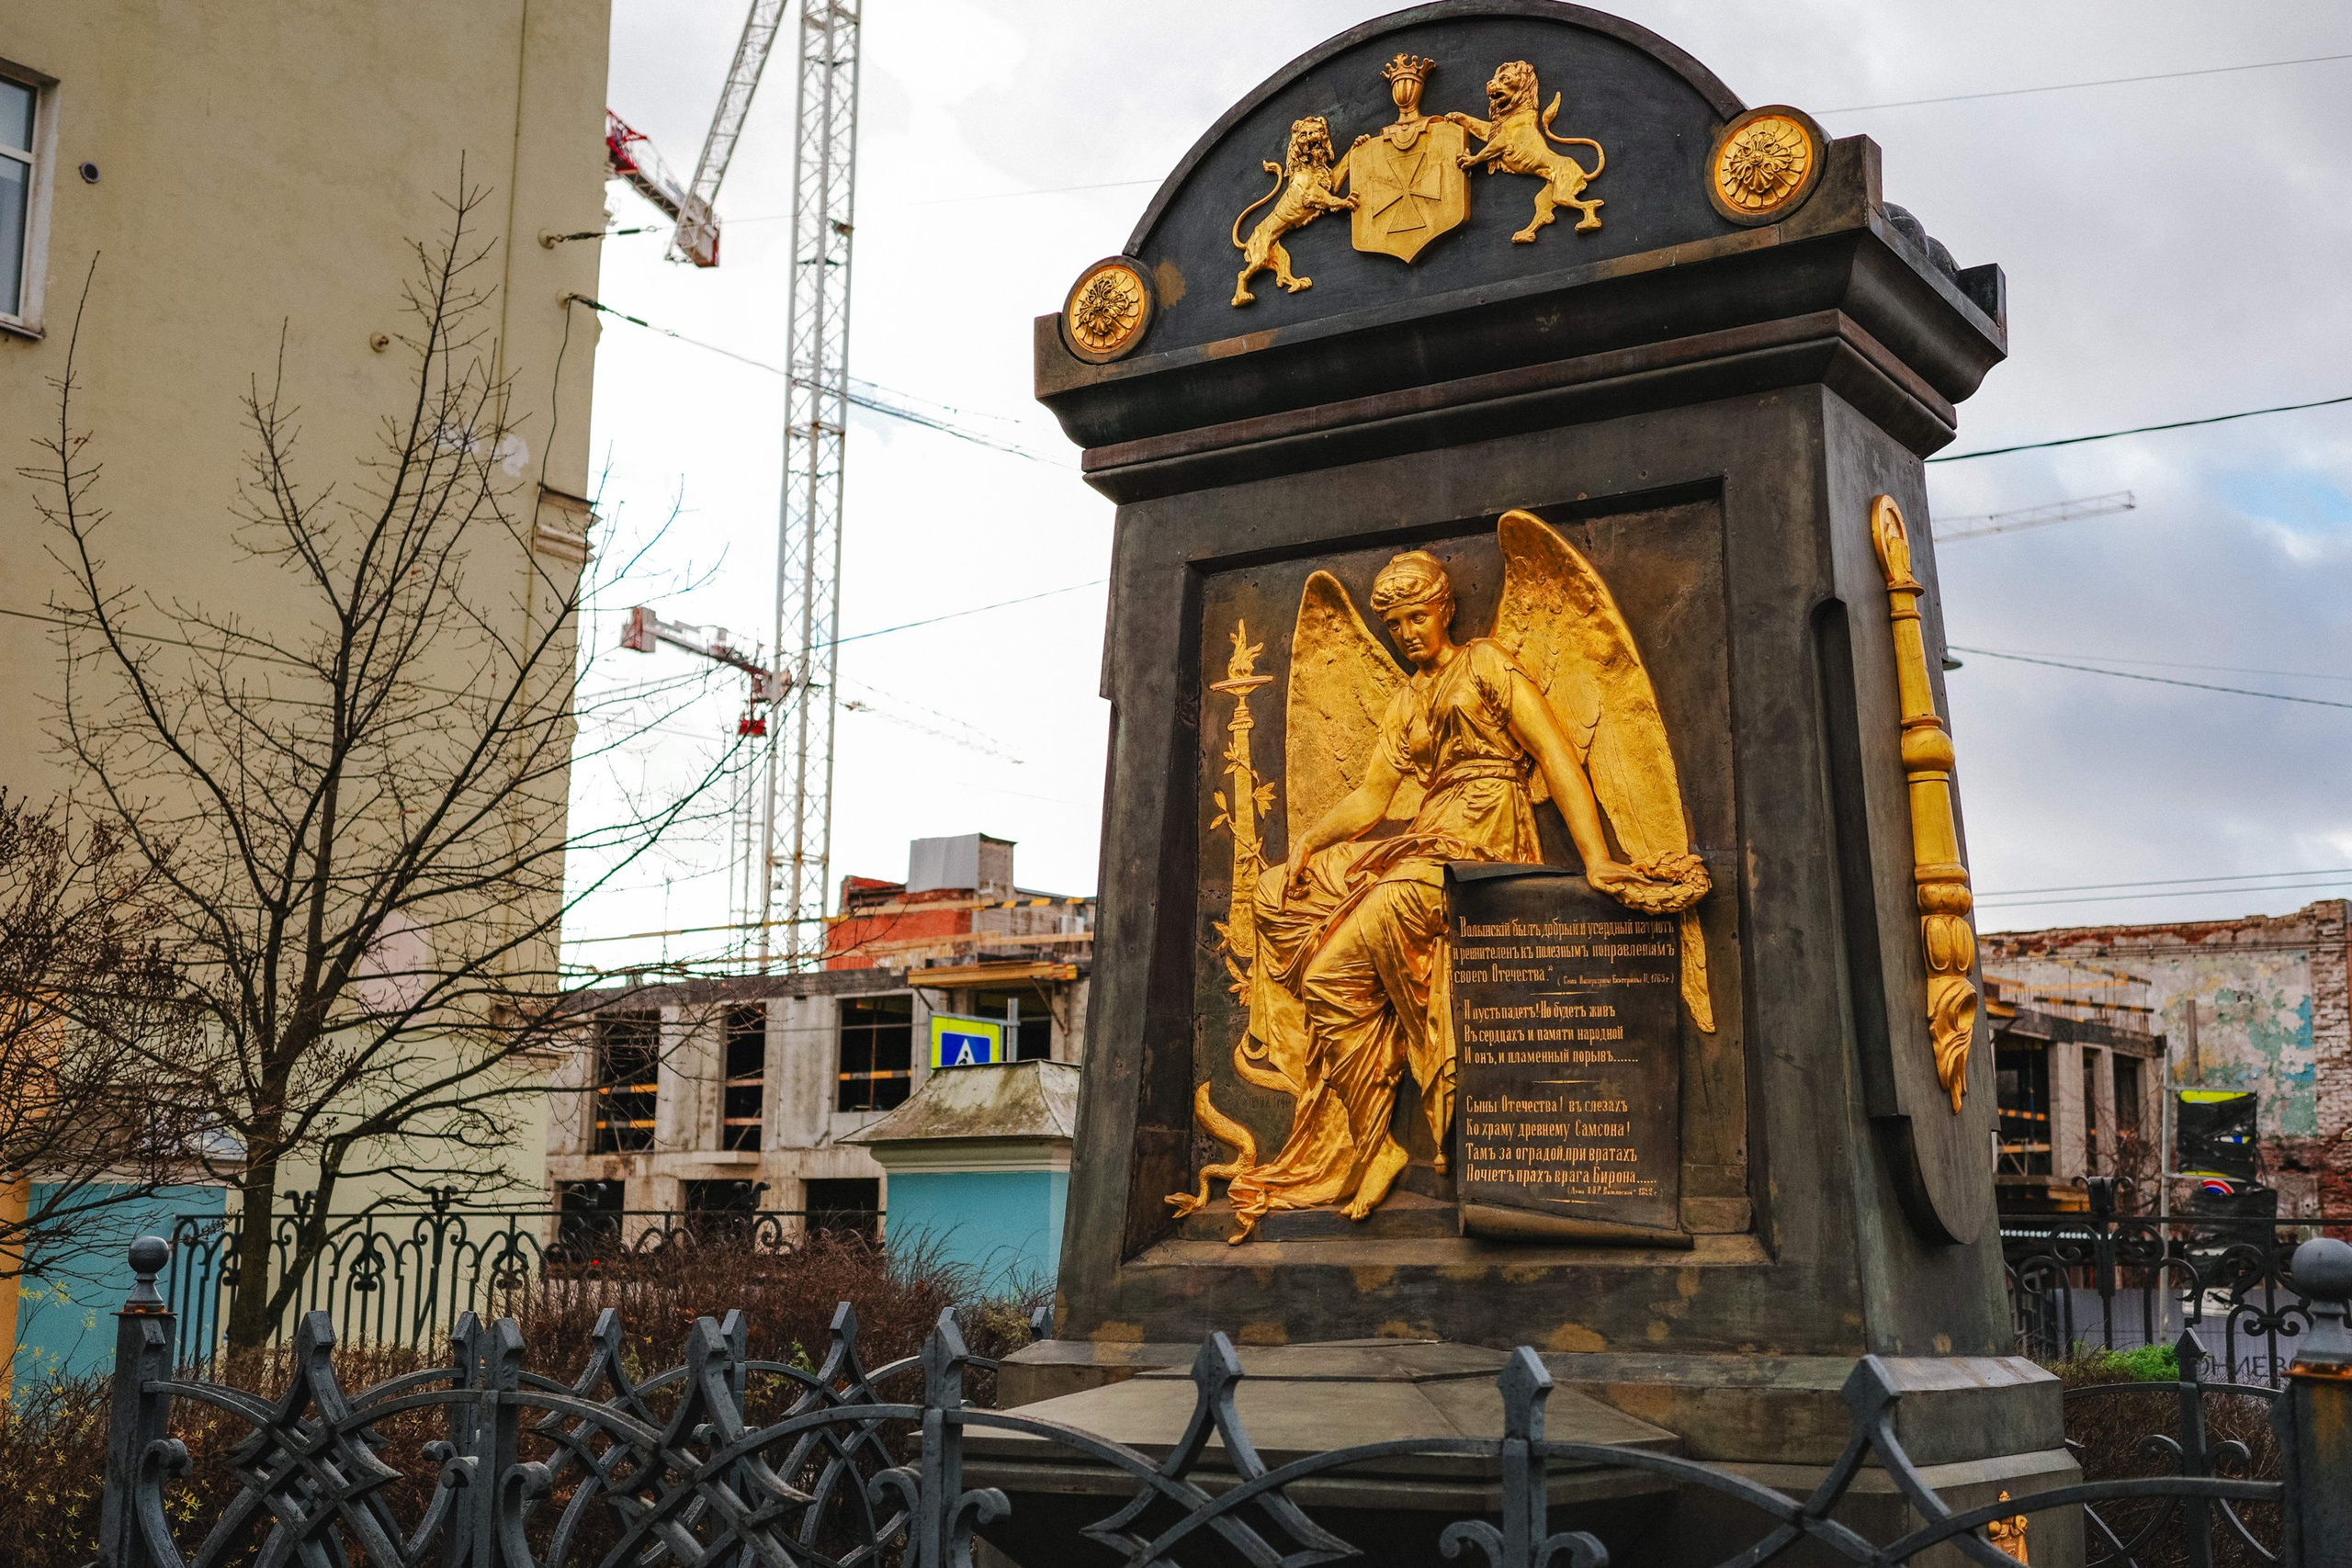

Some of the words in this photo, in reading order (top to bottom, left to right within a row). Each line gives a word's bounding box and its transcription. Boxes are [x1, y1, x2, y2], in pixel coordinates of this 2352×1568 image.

[1459, 916, 1510, 937] Волынскій
[1542, 917, 1578, 940] добрый
[1580, 922, 1586, 935] и
[1588, 919, 1633, 940] усердный
[1521, 947, 1533, 959] къ
[1535, 944, 1589, 959] полезнымъ
[1454, 970, 1487, 984] своего
[1464, 999, 1470, 1020] И
[1541, 1000, 1552, 1019] Но
[1554, 1001, 1587, 1021] будетъ
[1589, 1006, 1616, 1017] живъ
[1464, 1024, 1477, 1042] Въ
[1479, 1030, 1525, 1046] сердцахъ
[1528, 1030, 1533, 1041] и
[1537, 1029, 1574, 1041] памяти
[1577, 1026, 1623, 1045] народной
[1464, 1046, 1471, 1064] И
[1475, 1052, 1497, 1065] онъ,
[1498, 1052, 1505, 1063] и
[1508, 1048, 1569, 1063] пламенный
[1466, 1095, 1497, 1112] Сыны
[1568, 1100, 1582, 1111] въ
[1584, 1100, 1628, 1111] слезахъ
[1466, 1118, 1479, 1135] Ко
[1482, 1123, 1515, 1141] храму
[1518, 1123, 1570, 1142] древнему
[1576, 1119, 1630, 1136] Самсона!
[1465, 1143, 1496, 1160] Тамъ
[1498, 1147, 1511, 1160] за
[1566, 1148, 1586, 1166] при
[1589, 1148, 1637, 1165] вратахъ
[1467, 1164, 1514, 1182] Почіетъ
[1516, 1170, 1552, 1187] прахъ
[1555, 1170, 1589, 1187] врага
